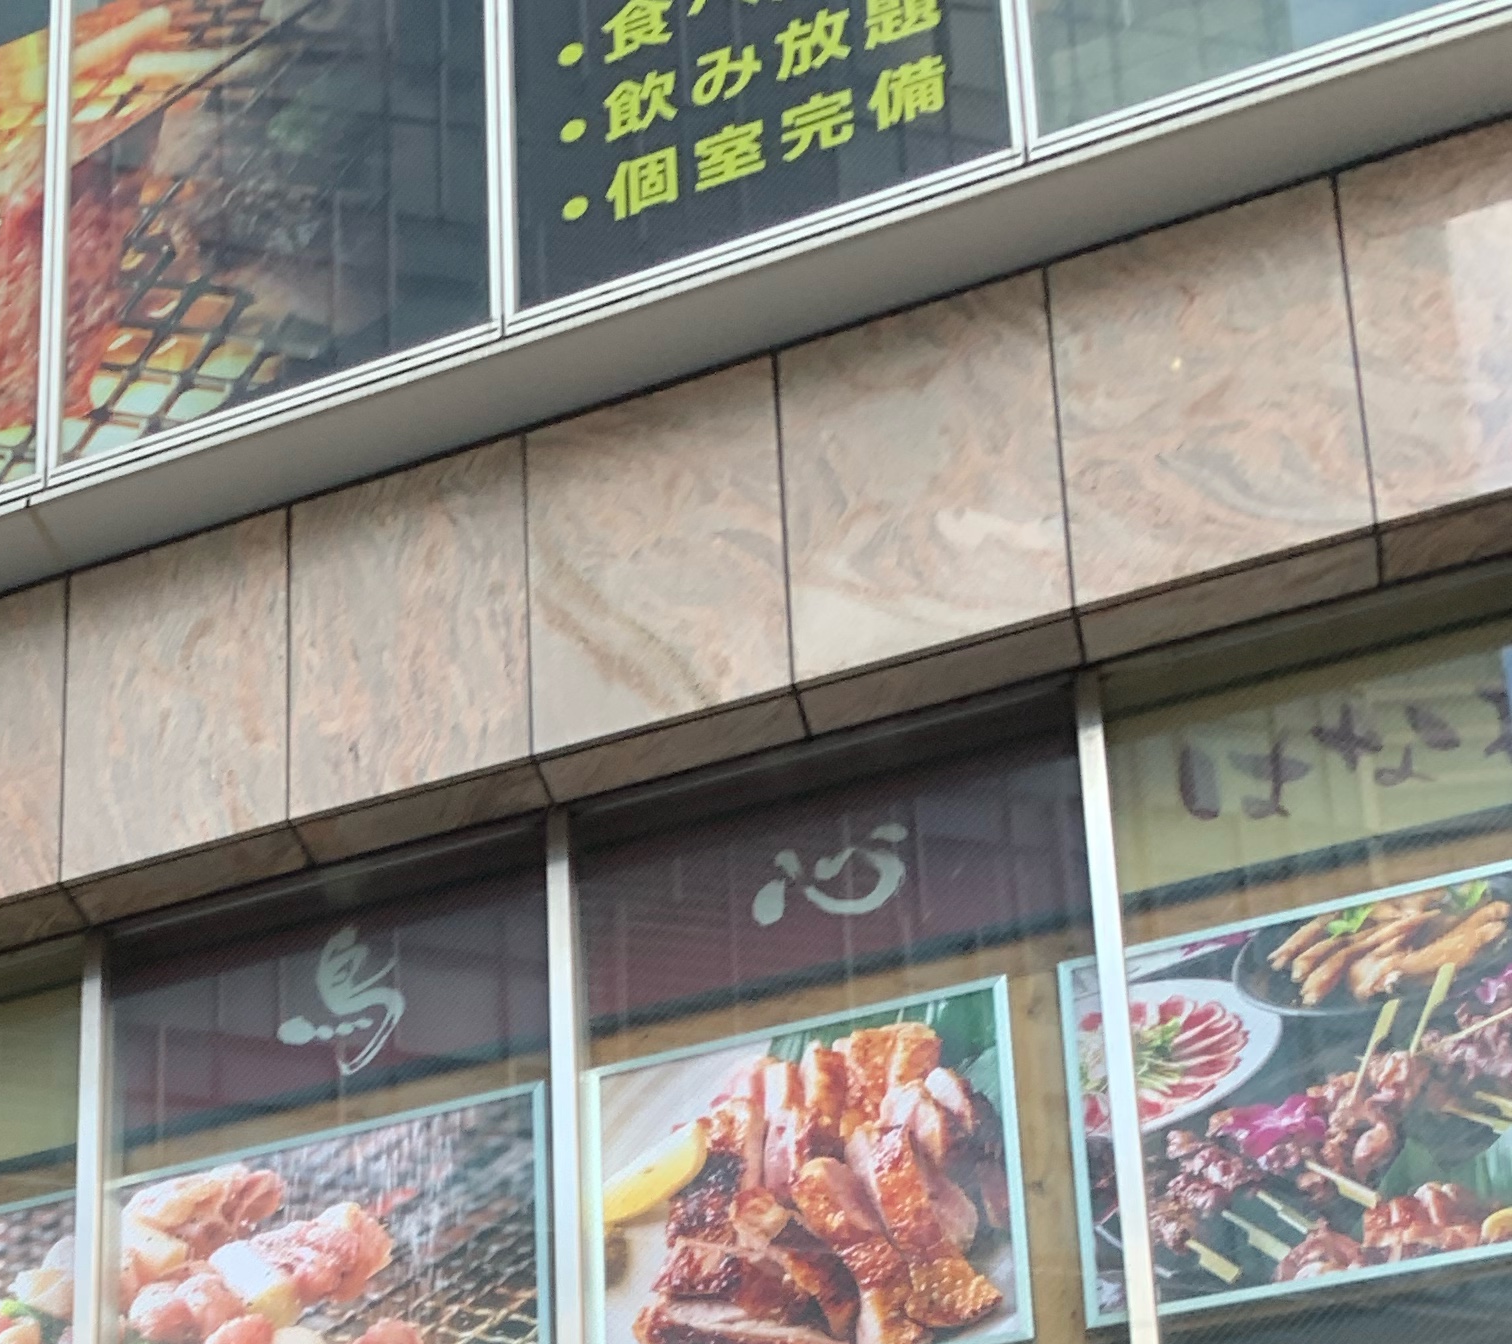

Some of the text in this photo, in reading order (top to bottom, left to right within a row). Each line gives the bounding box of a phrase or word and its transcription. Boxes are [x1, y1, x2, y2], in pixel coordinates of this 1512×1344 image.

[603, 0, 943, 143] 飲み放題
[605, 55, 947, 221] 個室完備
